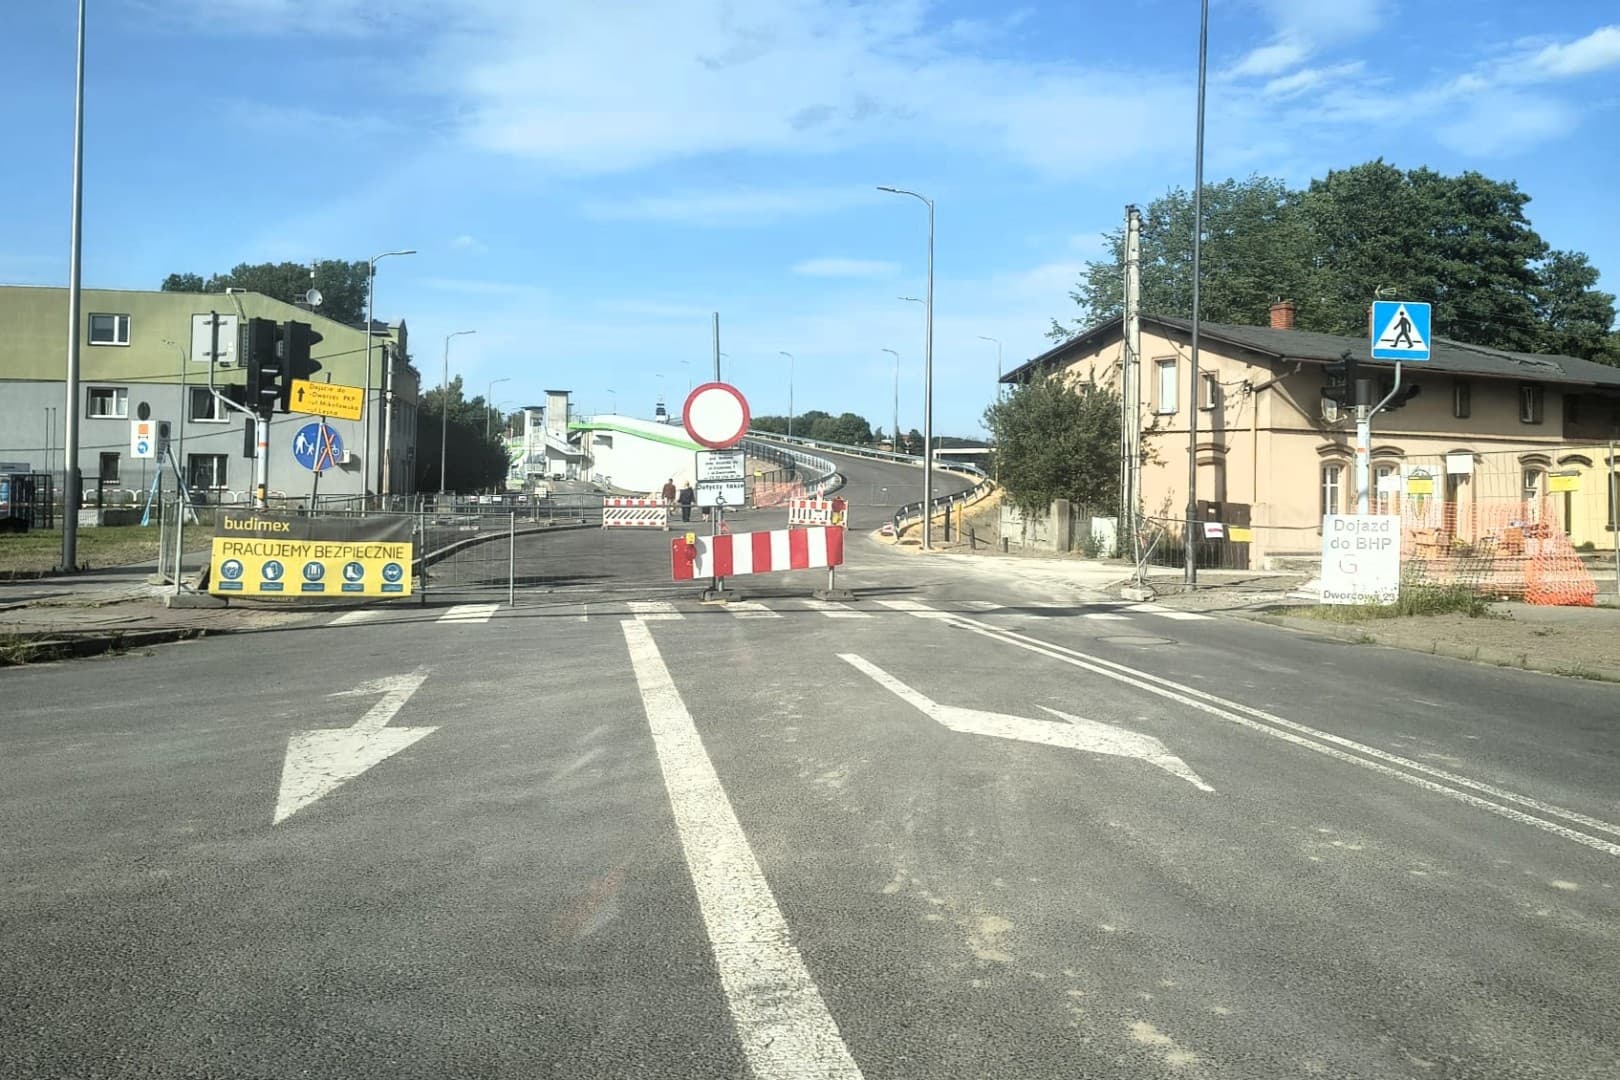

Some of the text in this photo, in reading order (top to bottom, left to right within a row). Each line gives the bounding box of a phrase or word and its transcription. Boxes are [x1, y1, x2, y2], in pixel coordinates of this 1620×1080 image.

[224, 515, 290, 533] budimex
[1334, 519, 1389, 534] Dojazd
[223, 541, 404, 560] PRACUJEMY BEZPIECZNIE
[1330, 537, 1392, 550] do BHP
